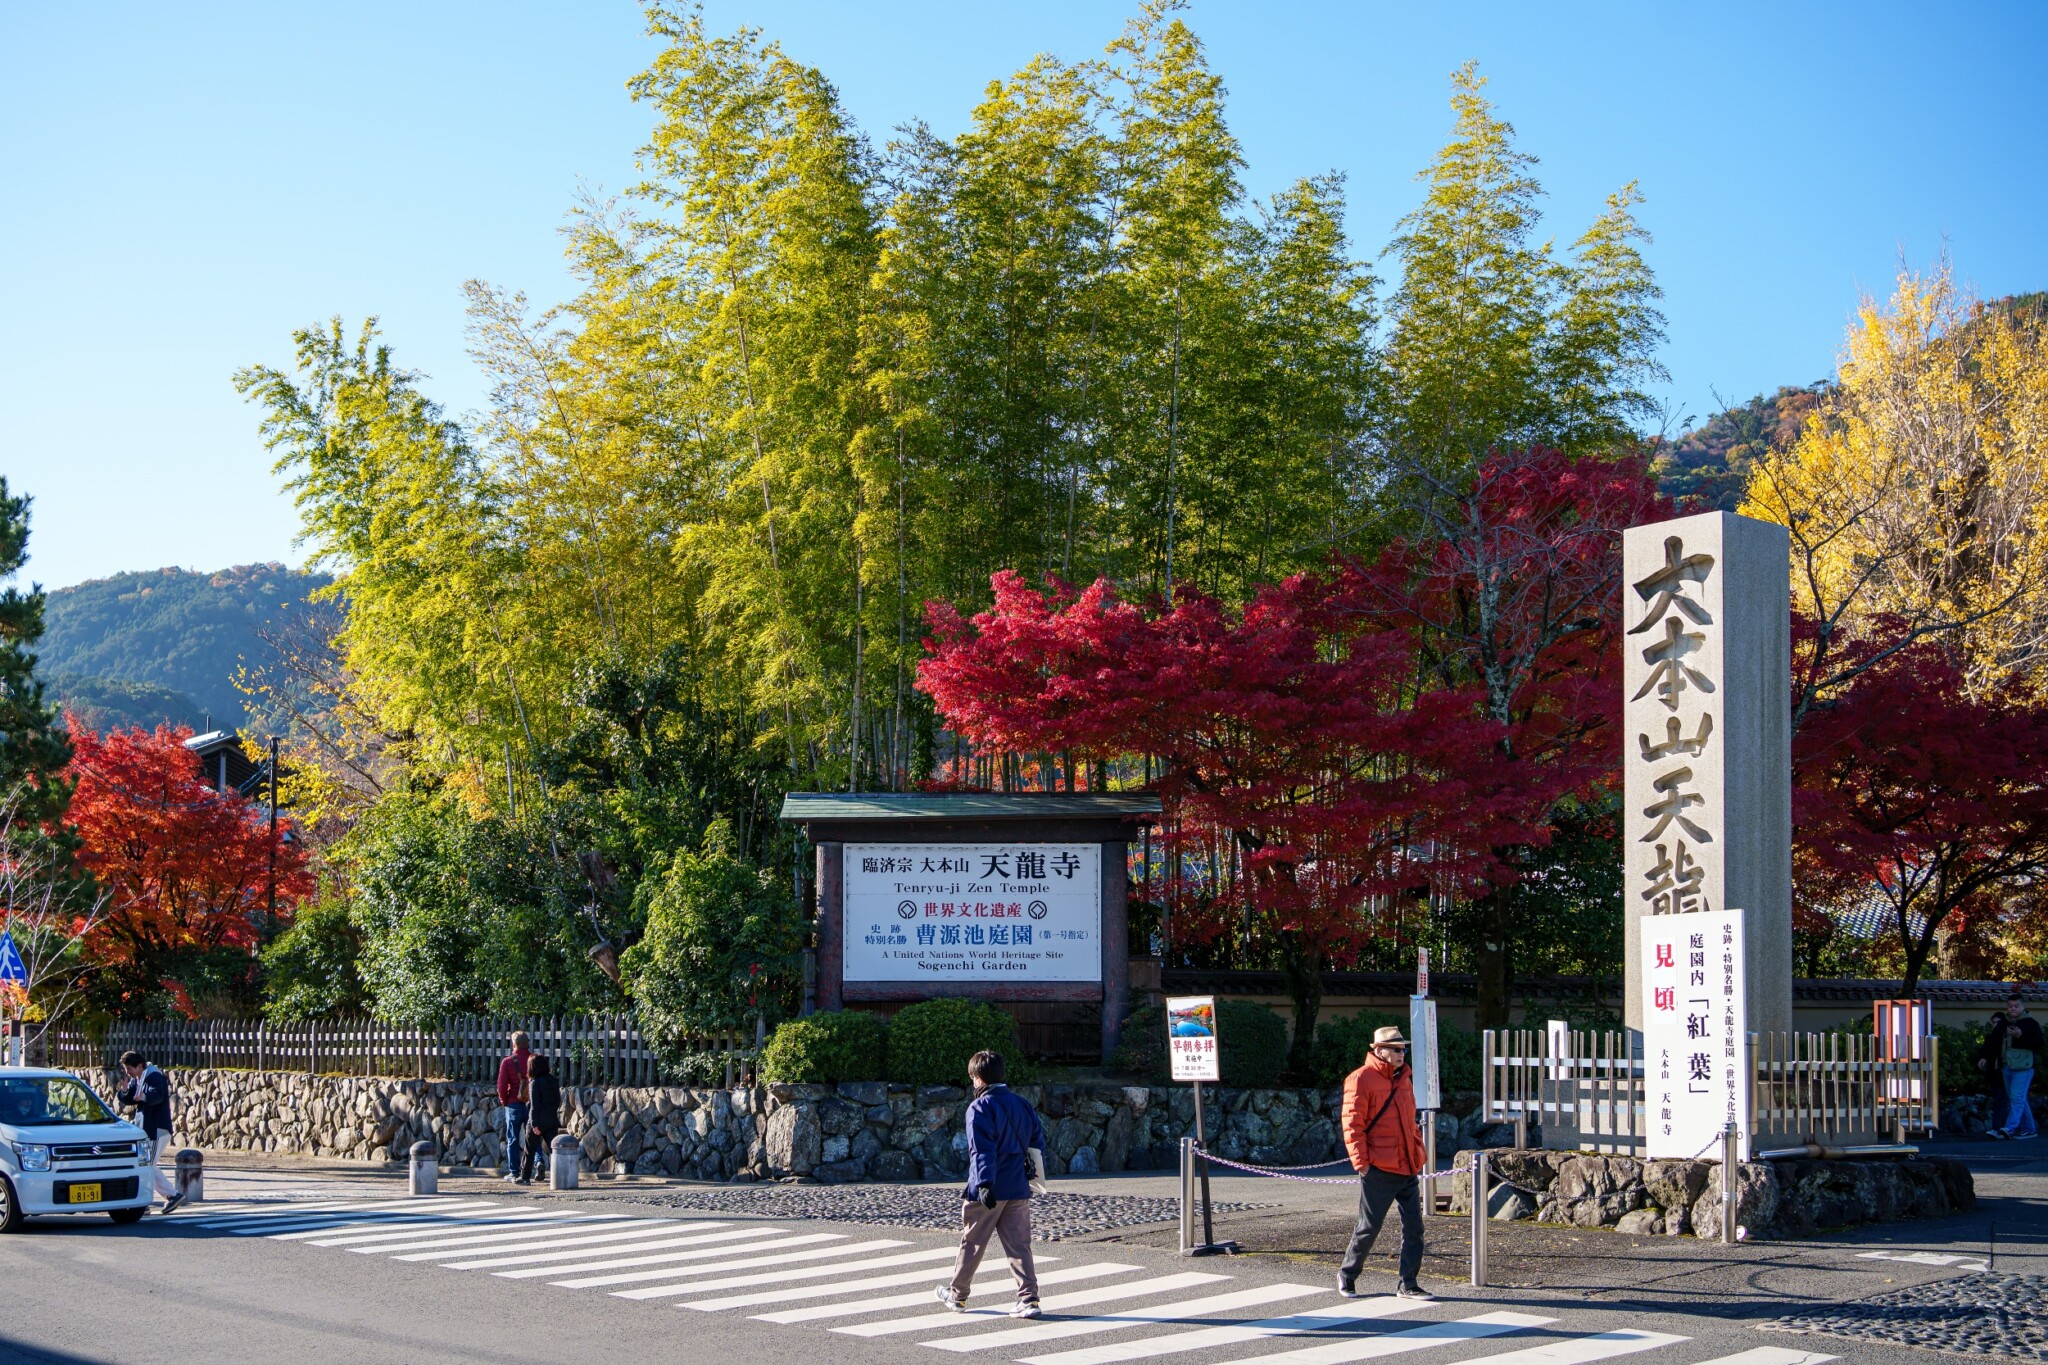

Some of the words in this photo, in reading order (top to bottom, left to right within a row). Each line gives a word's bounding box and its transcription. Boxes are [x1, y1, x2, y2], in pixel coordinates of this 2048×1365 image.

[1626, 535, 1715, 915] 大本山天龍
[862, 857, 913, 873] 臨済宗
[920, 857, 969, 873] 大本山
[980, 851, 1081, 879] 天龍寺
[894, 883, 960, 895] Tenryu-ji
[967, 883, 992, 893] Zen
[1000, 883, 1050, 895] Temple
[923, 902, 1022, 917] 世界文化遺産
[870, 924, 902, 934] 史跡
[916, 923, 1033, 946] 曹源池庭園
[864, 934, 907, 945] 特別名勝
[882, 951, 889, 959] A
[893, 951, 925, 959] United
[929, 951, 964, 959] Nations
[968, 951, 997, 959] World
[1001, 951, 1041, 960] Heritage
[1045, 951, 1064, 959] Site
[917, 960, 974, 972] Sogenchi
[981, 960, 1027, 971] Garden
[1654, 943, 1675, 1011] 見頃
[1723, 923, 1736, 1122] 史跡・特別名勝・天龍寺庭園（世界文化遺
[1173, 1039, 1214, 1053] 早朝参拝
[1661, 1049, 1669, 1079] 大本山
[1661, 1092, 1672, 1136] 天龍寺
[77, 1191, 99, 1201] 81-91
